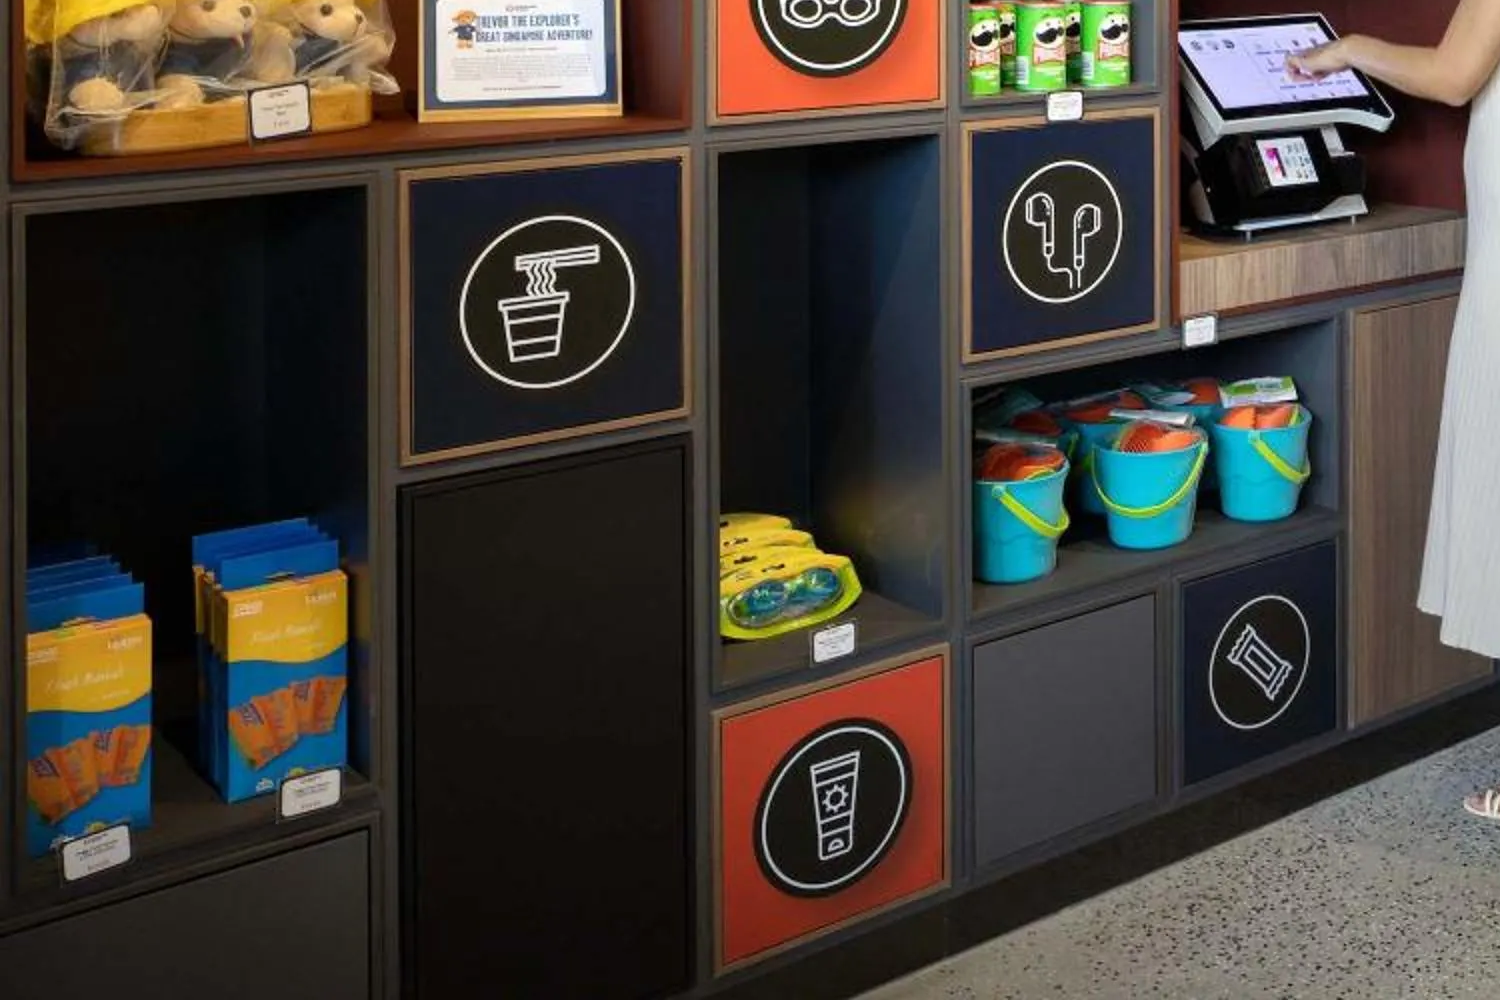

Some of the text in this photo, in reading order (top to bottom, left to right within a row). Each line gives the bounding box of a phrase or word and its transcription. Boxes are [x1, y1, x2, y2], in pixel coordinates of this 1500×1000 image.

[477, 12, 581, 29] TREVOR THE EXPLORER'S
[476, 31, 501, 43] GREAT
